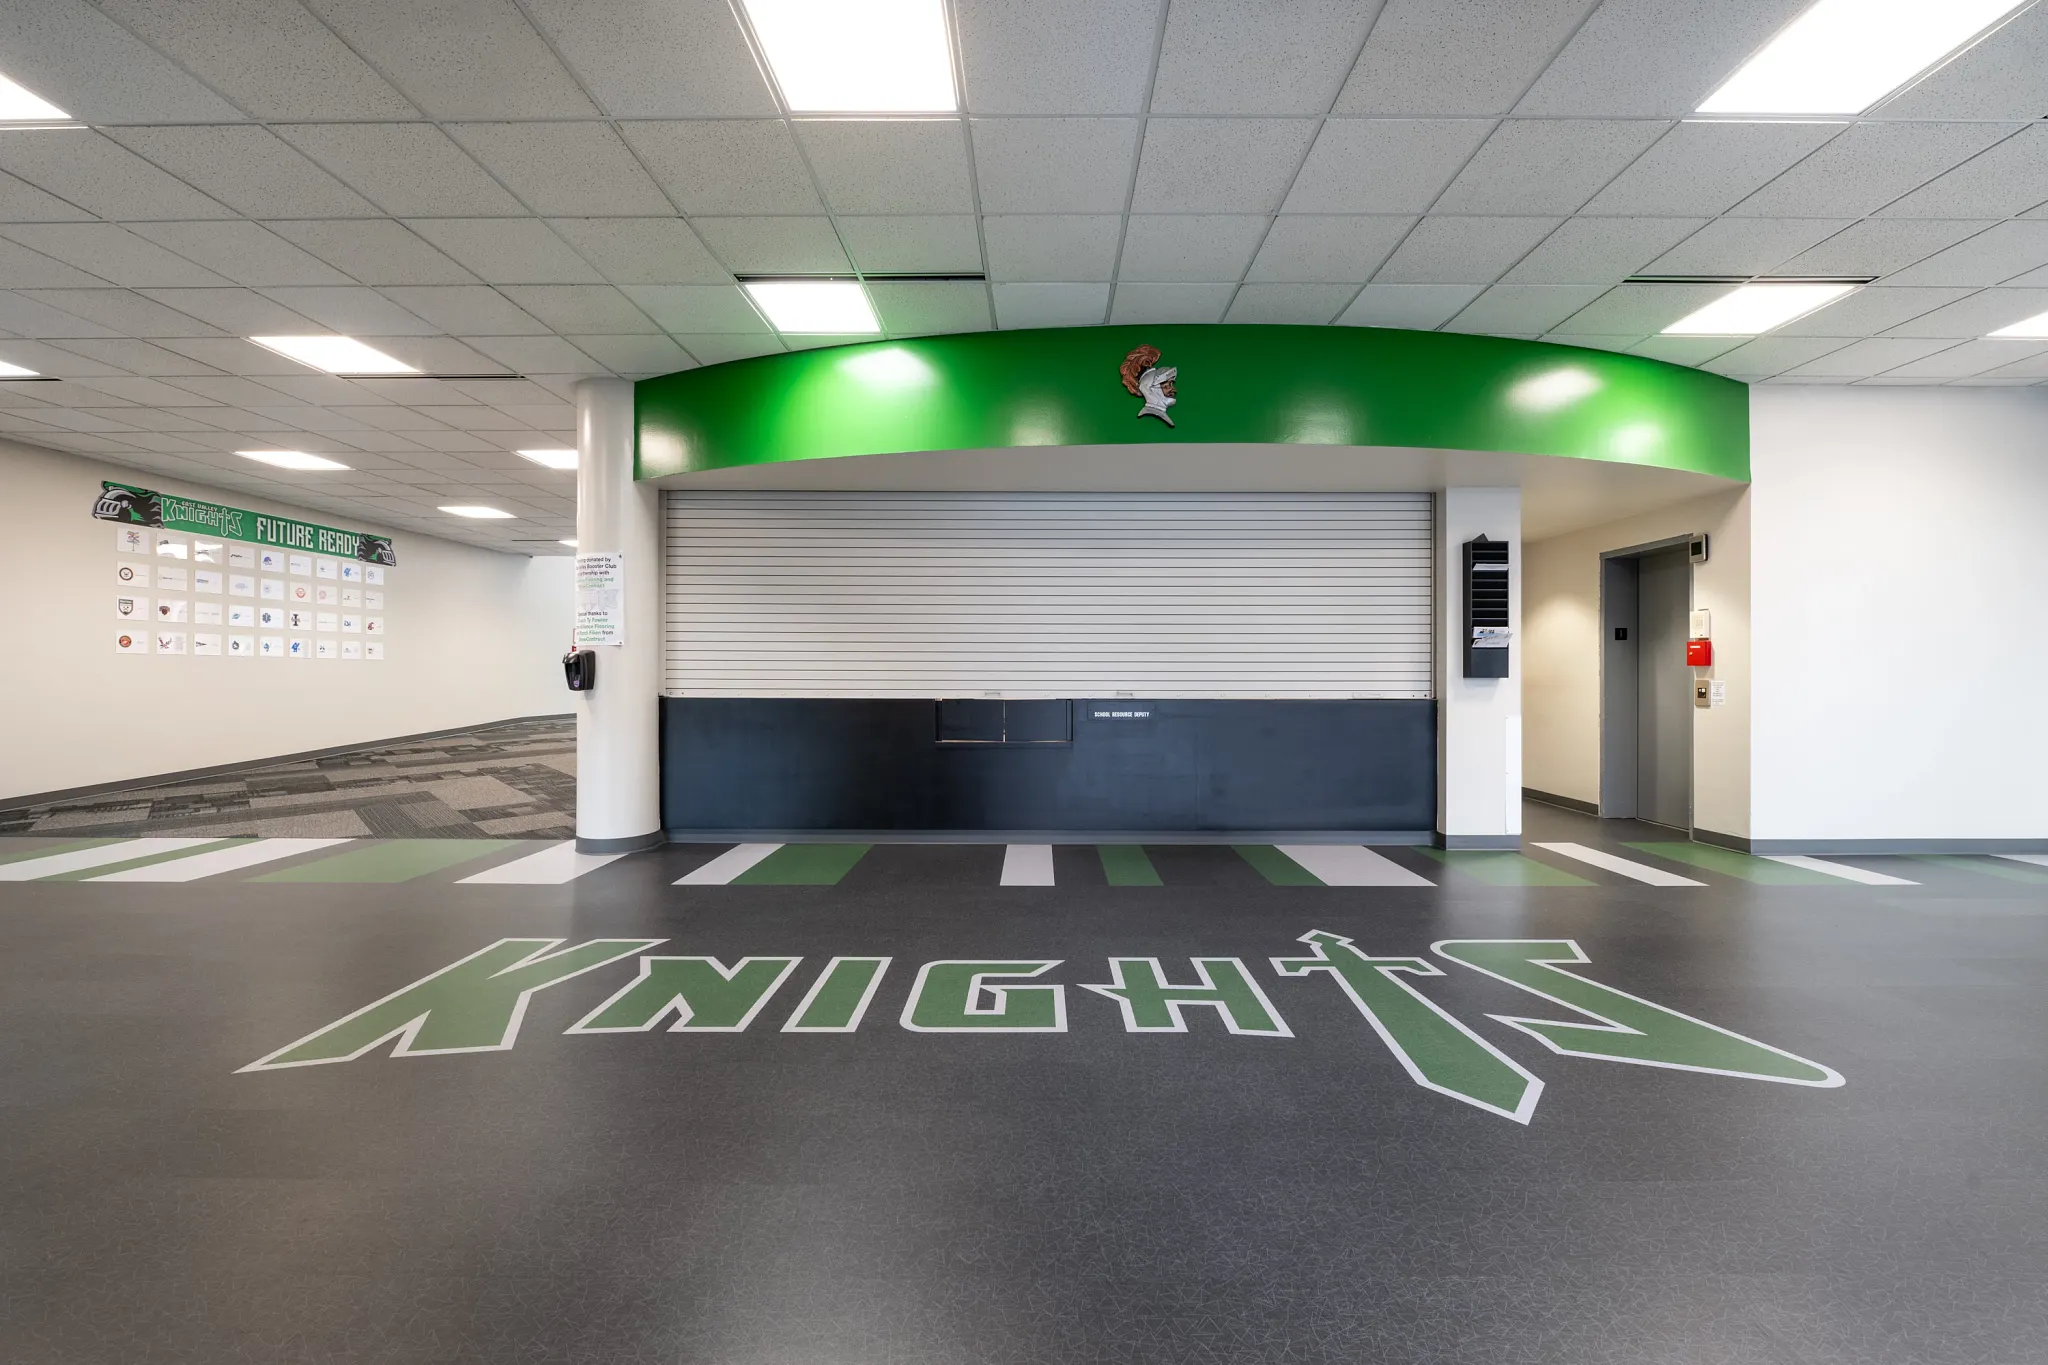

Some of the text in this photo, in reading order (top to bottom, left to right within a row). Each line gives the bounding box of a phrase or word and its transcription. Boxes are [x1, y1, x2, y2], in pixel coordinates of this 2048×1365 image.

[256, 516, 360, 557] FUTURE READY
[231, 929, 1847, 1127] KNIGHTS
